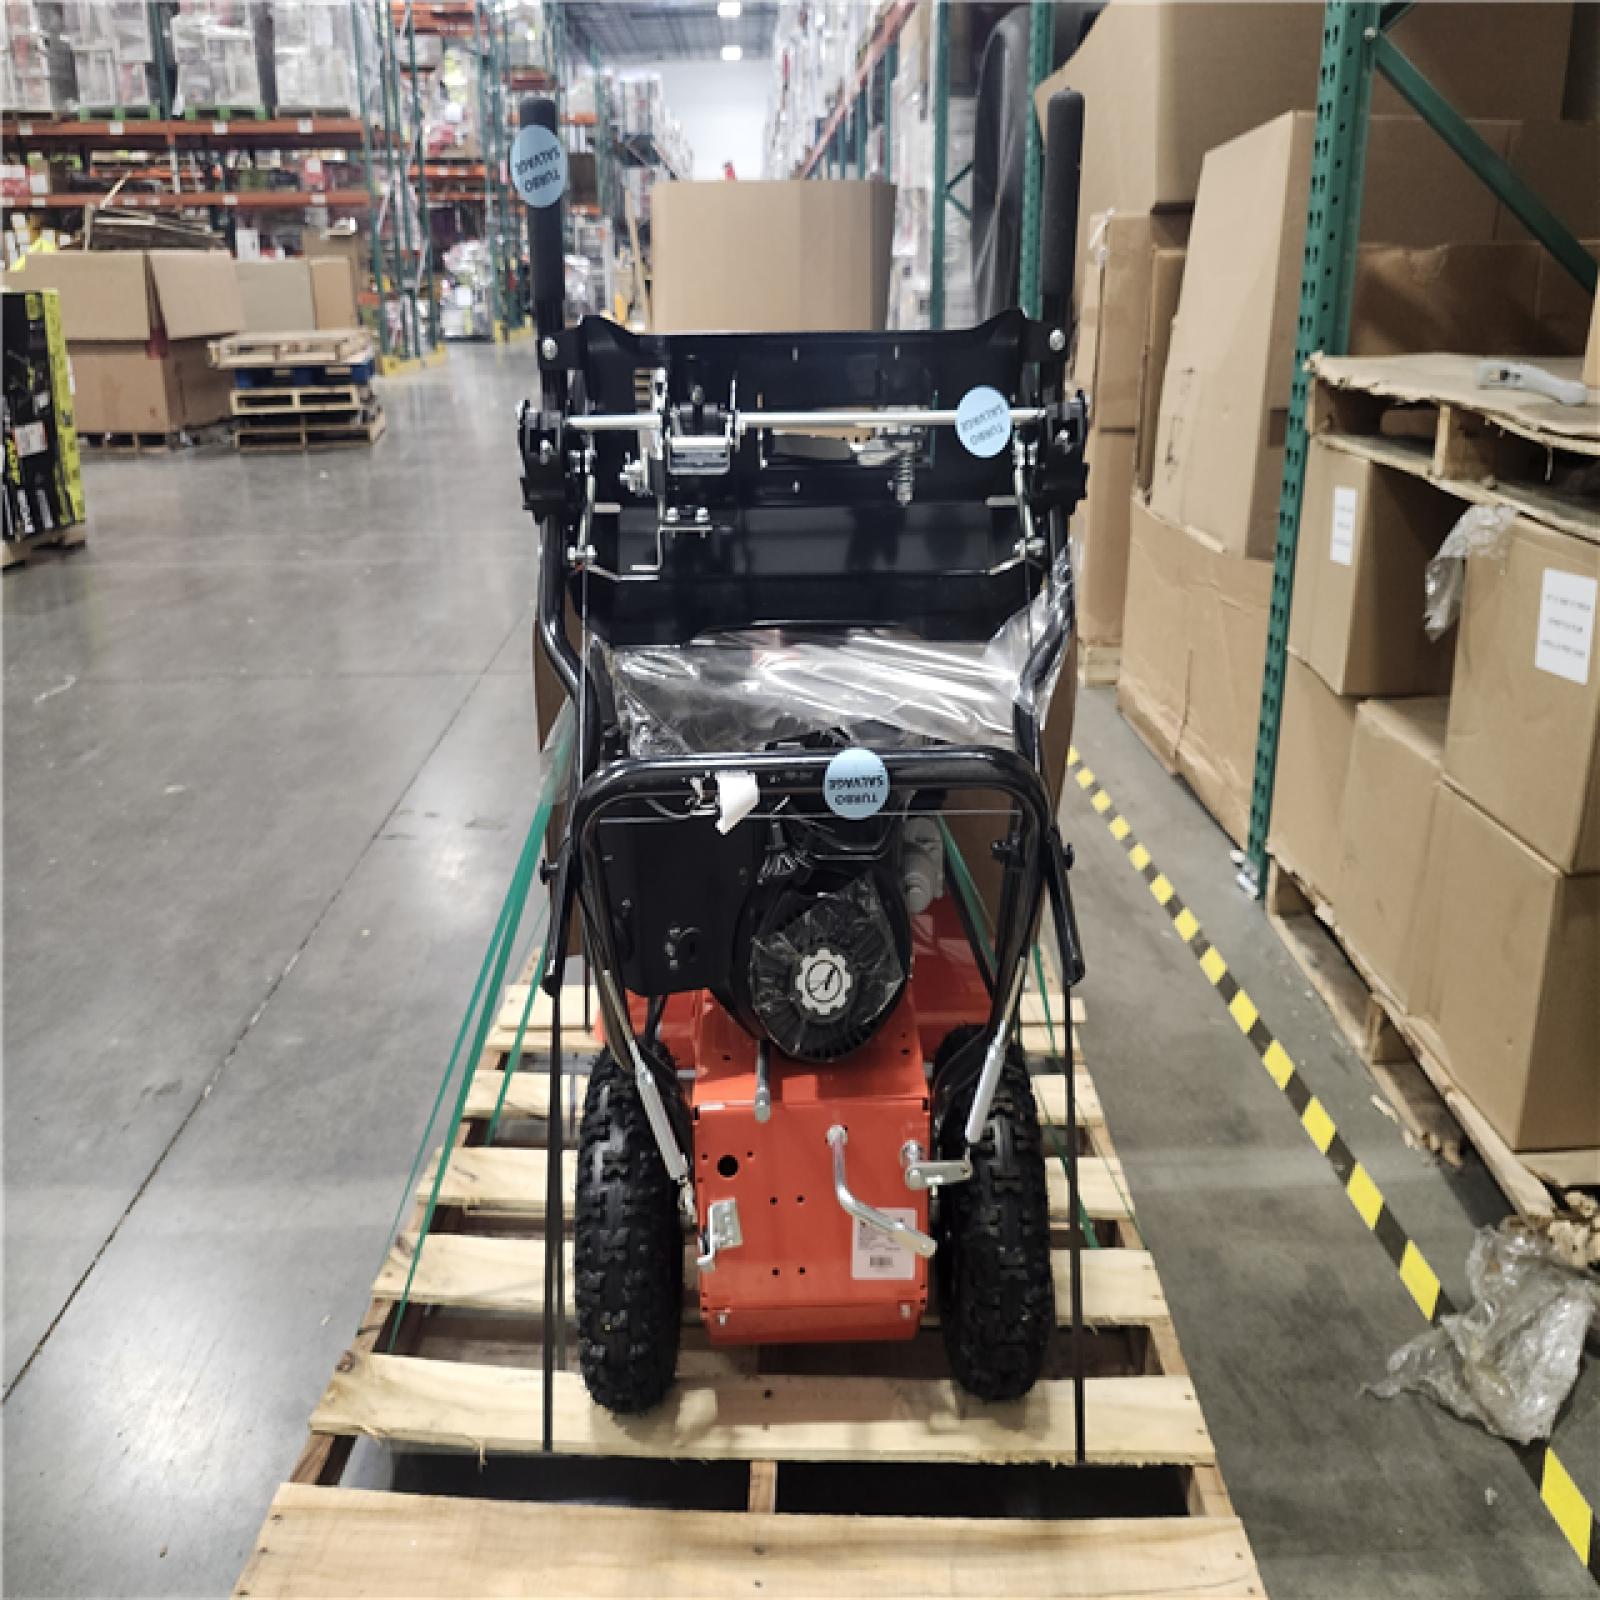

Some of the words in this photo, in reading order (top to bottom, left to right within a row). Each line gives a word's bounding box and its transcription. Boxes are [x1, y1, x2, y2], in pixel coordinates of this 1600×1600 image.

[515, 145, 560, 175] SALVAGE
[524, 168, 560, 193] TURBO
[960, 404, 1003, 431] SALVAGE
[970, 422, 1004, 445] TURBO
[829, 775, 883, 790] SALVAGE
[834, 793, 878, 805] TURBO
